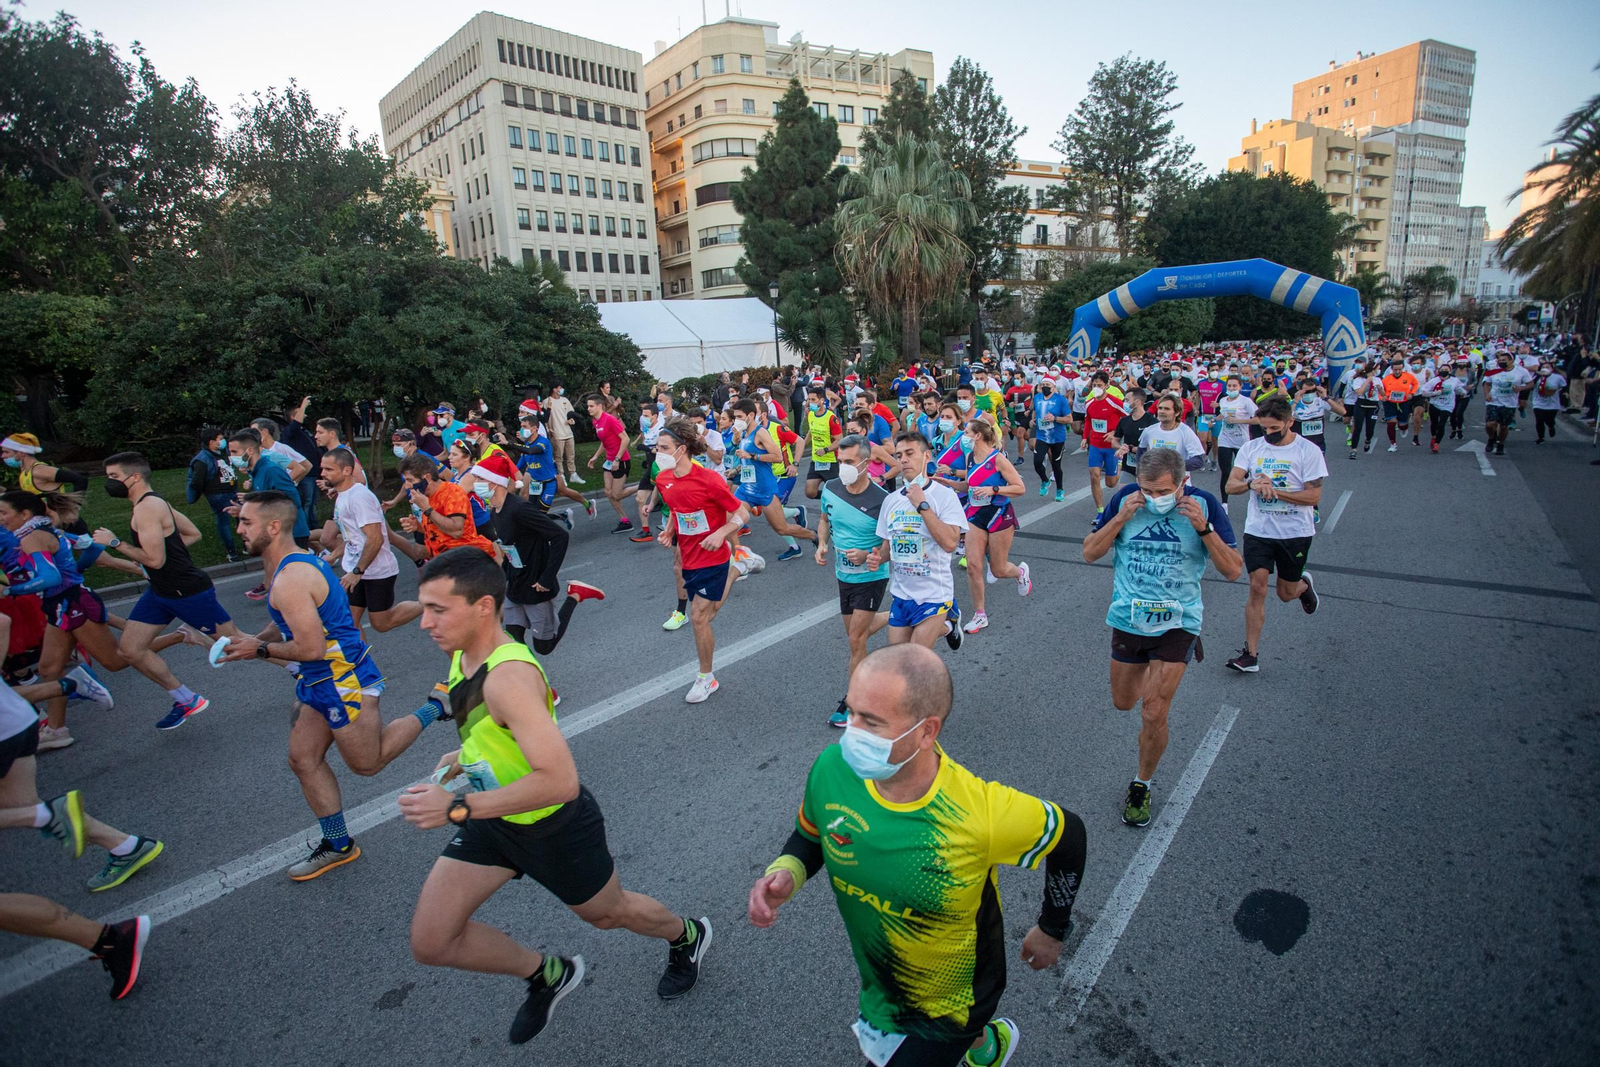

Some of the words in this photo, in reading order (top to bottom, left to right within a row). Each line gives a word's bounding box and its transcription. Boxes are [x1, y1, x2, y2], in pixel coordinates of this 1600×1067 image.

[1217, 270, 1247, 278] DEPORTES
[684, 519, 698, 529] 79
[892, 543, 918, 554] 1253
[1132, 542, 1182, 557] TRAIL
[842, 557, 861, 567] 56
[1144, 556, 1158, 564] DEL
[1144, 611, 1173, 624] 710
[832, 875, 923, 922] SPALL
